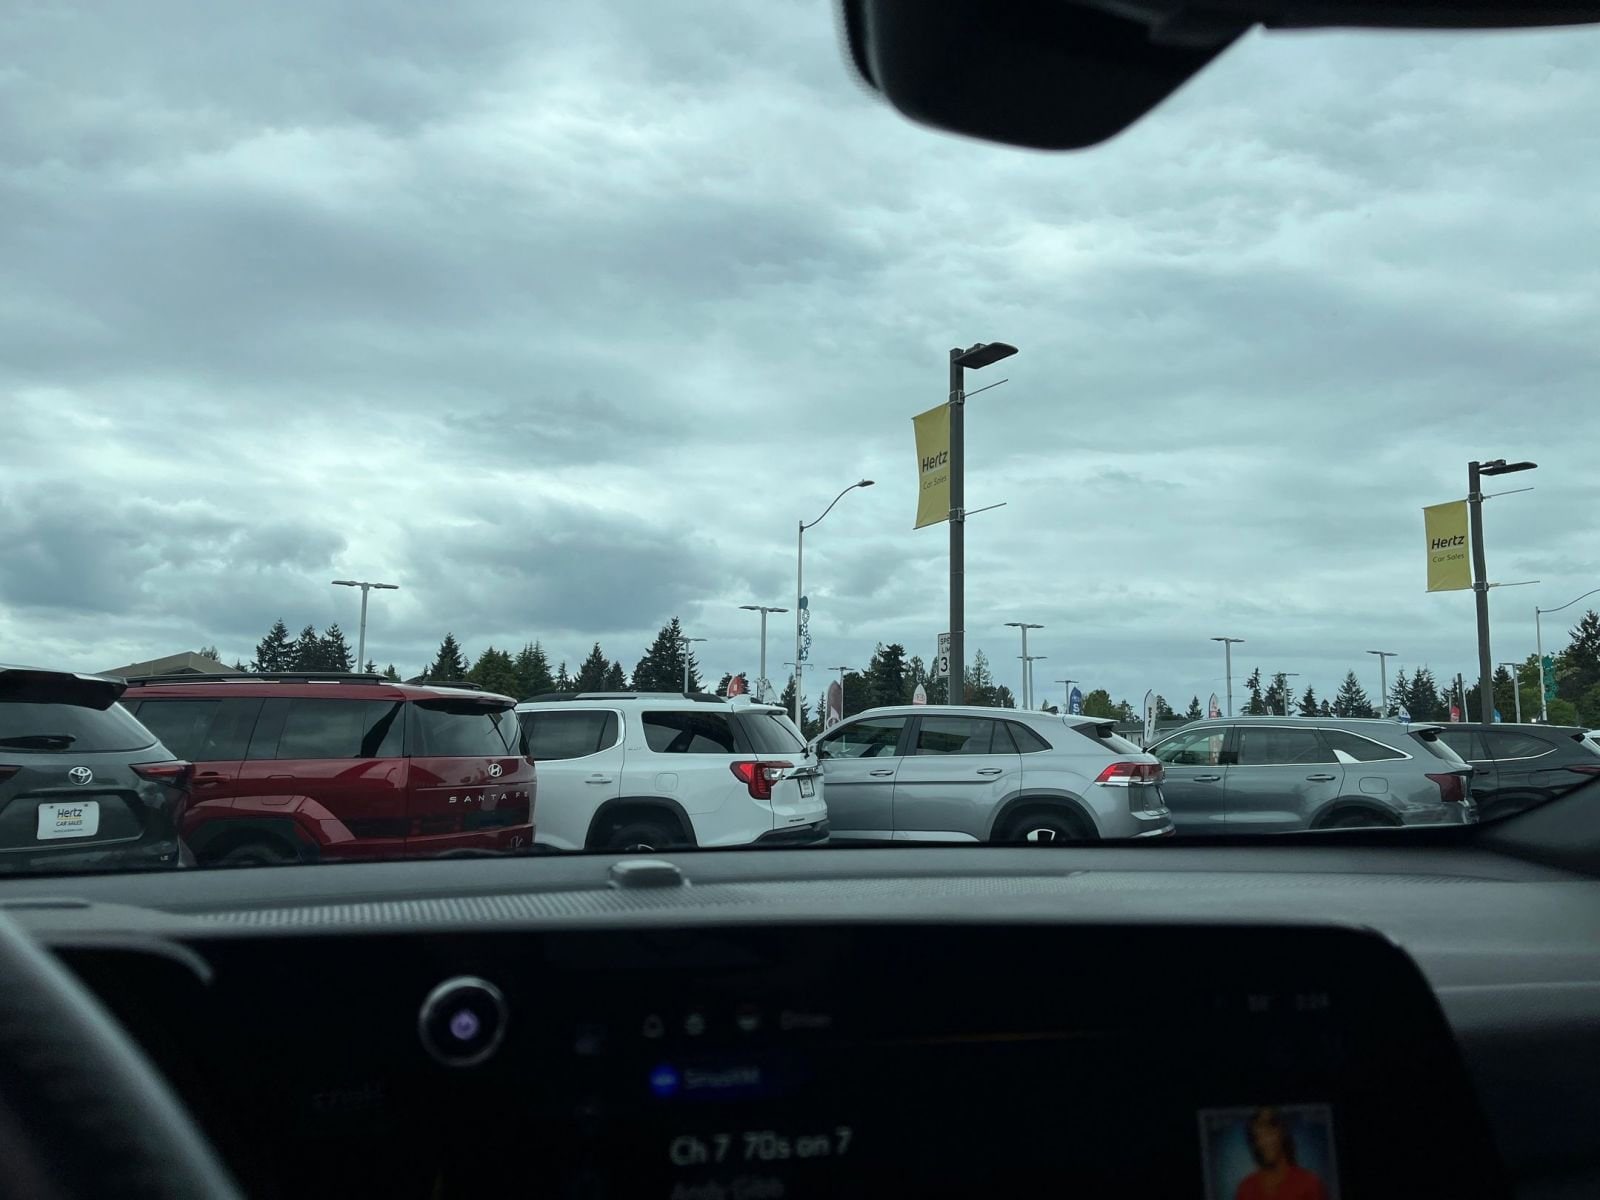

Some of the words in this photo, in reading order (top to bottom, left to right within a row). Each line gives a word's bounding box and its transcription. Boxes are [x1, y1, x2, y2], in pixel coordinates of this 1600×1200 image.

[922, 451, 948, 472] Hertz
[923, 479, 933, 490] Car
[934, 475, 947, 485] Sales
[1431, 535, 1465, 550] Hertz
[1447, 553, 1464, 561] Sales
[940, 637, 950, 645] SPE
[449, 793, 507, 803] SANTA
[515, 791, 528, 799] FE
[57, 808, 82, 818] Hertz
[670, 1134, 707, 1166] Ch
[713, 1132, 732, 1163] 7
[743, 1129, 791, 1160] 70s
[797, 1134, 830, 1157] on
[835, 1125, 853, 1155] 7
